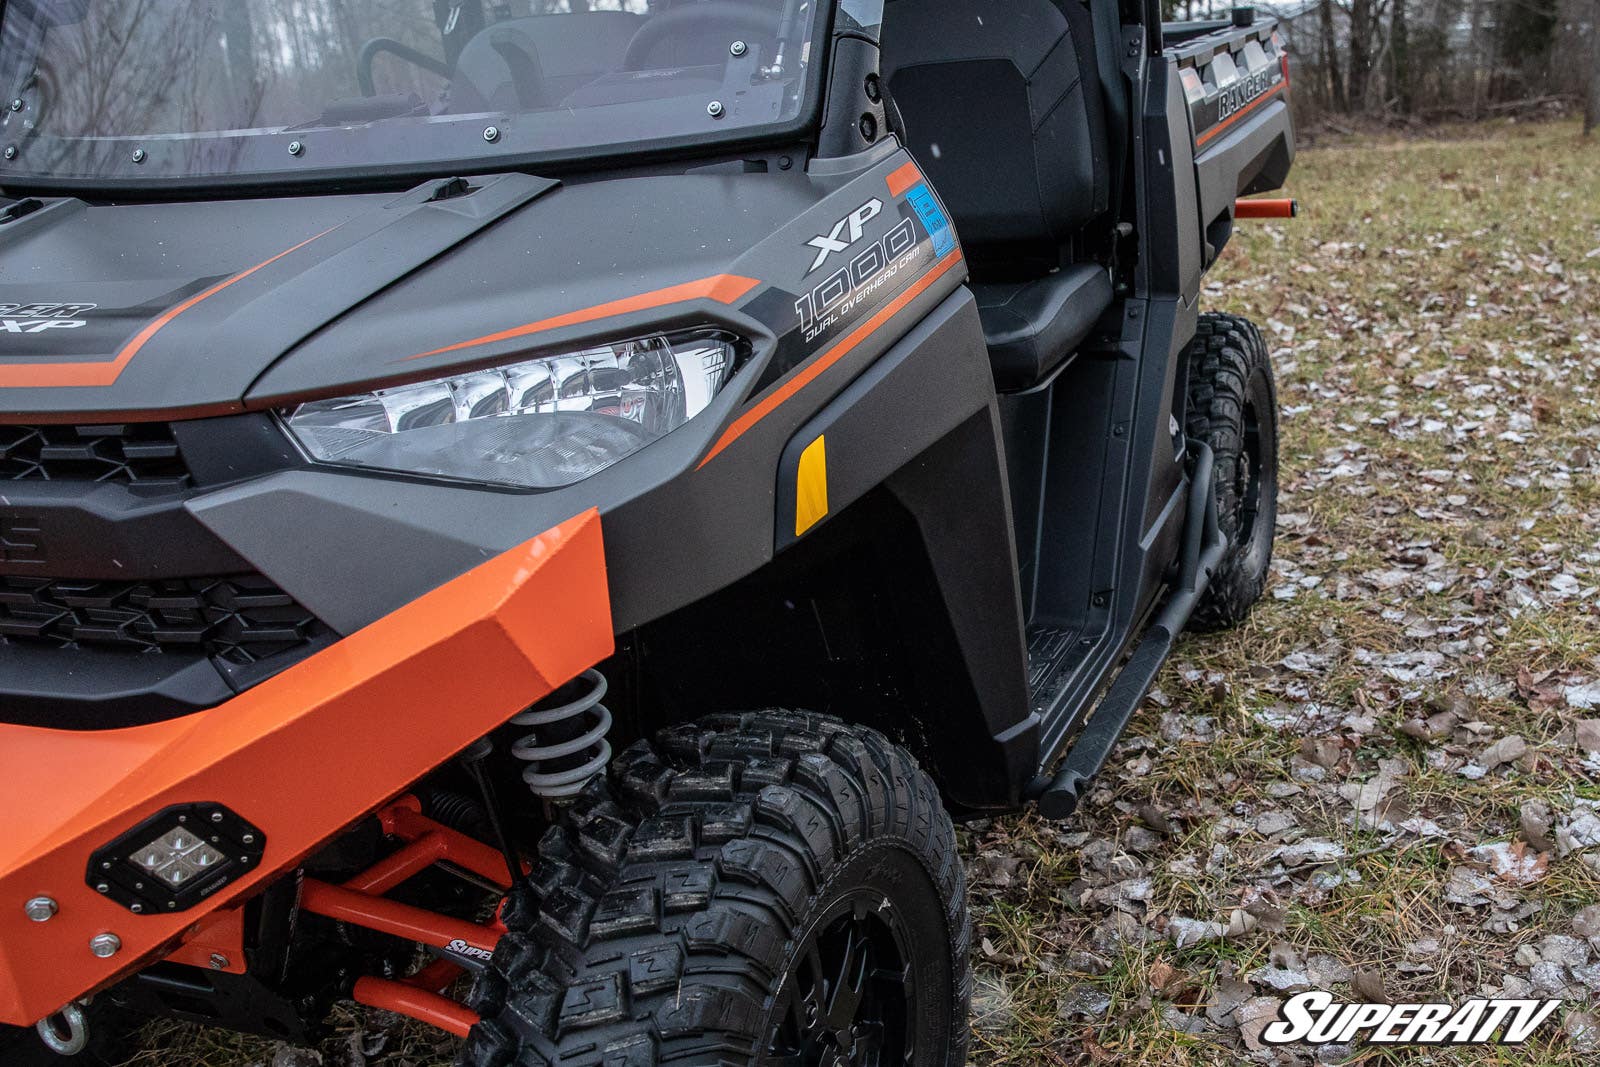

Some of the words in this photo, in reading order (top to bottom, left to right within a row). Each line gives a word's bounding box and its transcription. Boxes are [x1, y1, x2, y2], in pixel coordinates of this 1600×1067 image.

[1218, 68, 1269, 121] RANGER
[794, 216, 917, 333] 1000
[804, 197, 884, 276] XP
[805, 311, 839, 343] DUAL
[841, 266, 898, 316] OVERHEAD
[899, 246, 920, 269] CAM
